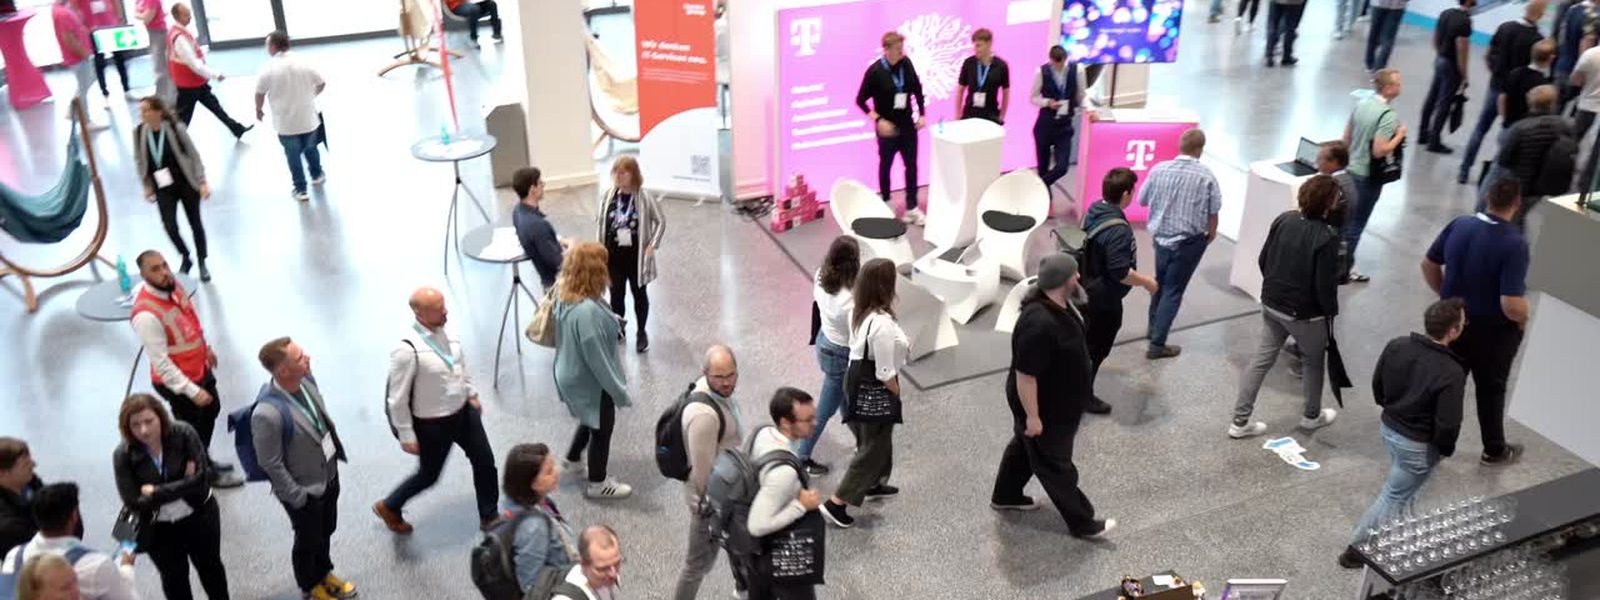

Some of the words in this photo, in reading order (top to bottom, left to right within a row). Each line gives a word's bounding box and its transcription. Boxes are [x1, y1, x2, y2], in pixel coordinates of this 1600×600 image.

[640, 40, 658, 49] Wir
[790, 16, 821, 57] T
[1126, 139, 1156, 171] T
